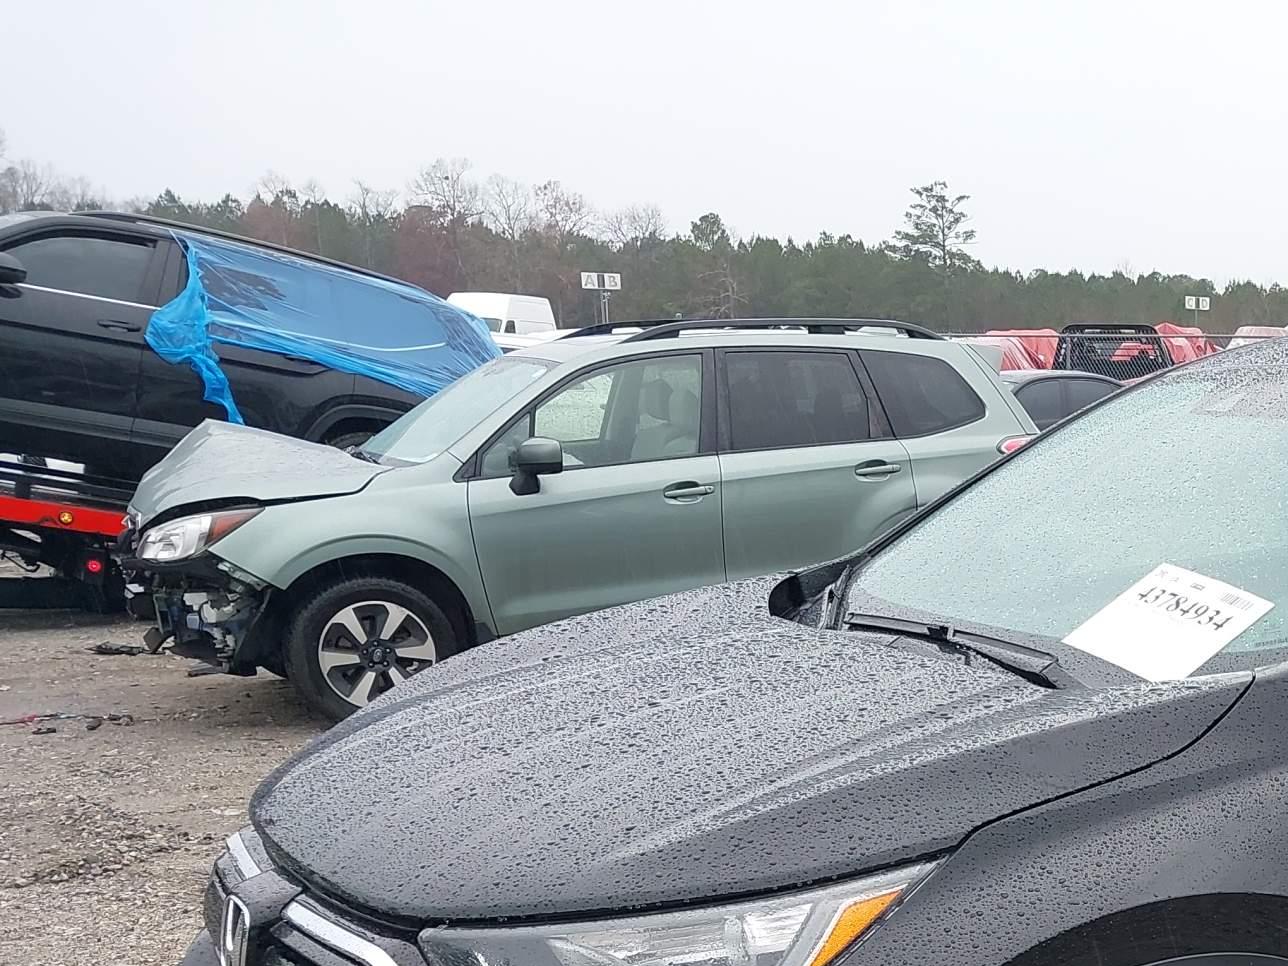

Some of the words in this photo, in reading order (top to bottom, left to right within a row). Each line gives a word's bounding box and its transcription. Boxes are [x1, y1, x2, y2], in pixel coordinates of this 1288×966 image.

[583, 274, 596, 287] A
[607, 275, 618, 287] B
[1137, 586, 1234, 631] 43784934
